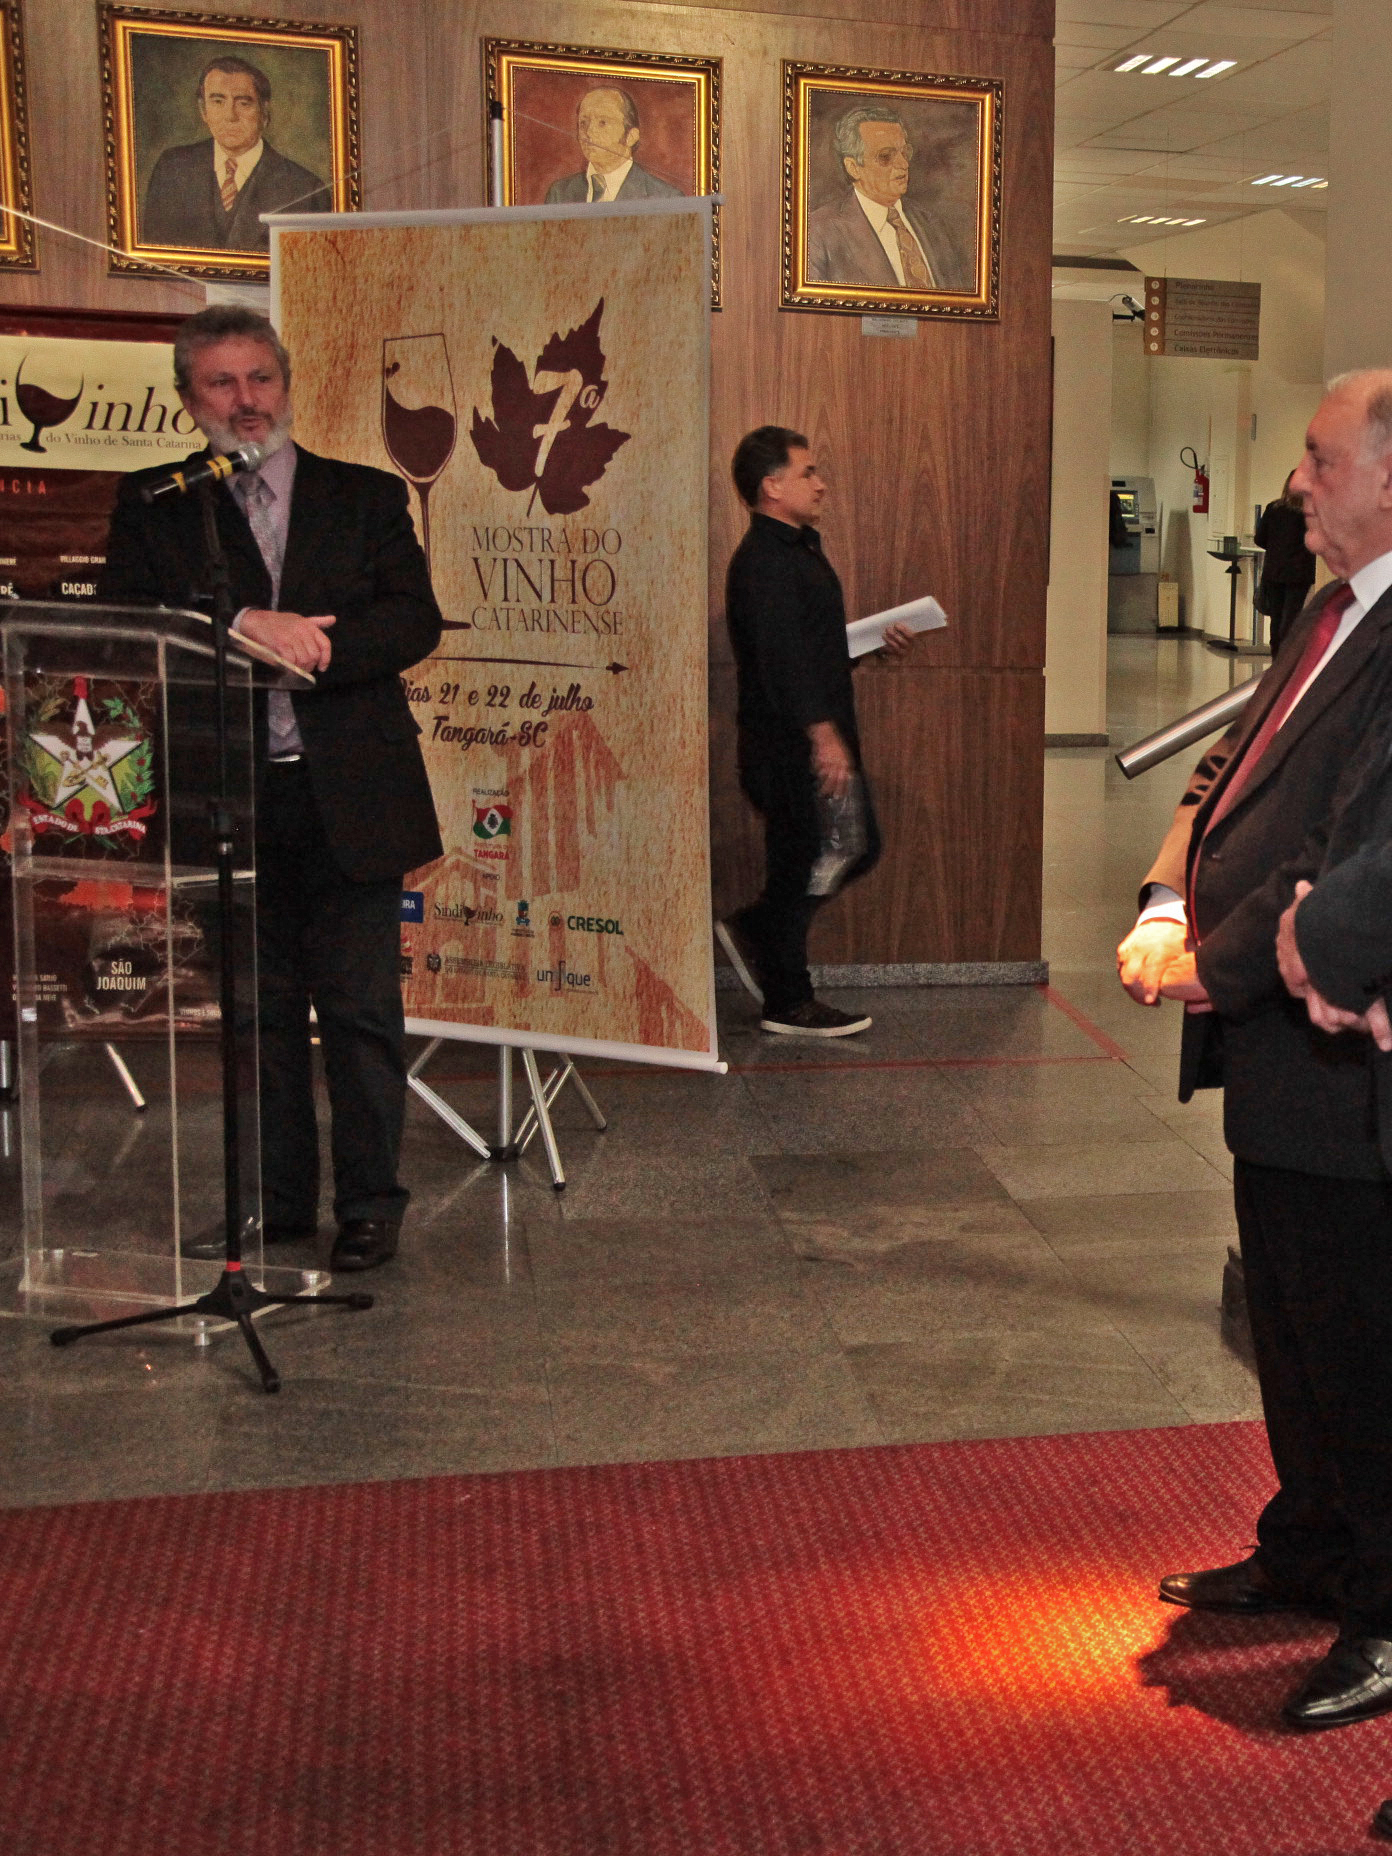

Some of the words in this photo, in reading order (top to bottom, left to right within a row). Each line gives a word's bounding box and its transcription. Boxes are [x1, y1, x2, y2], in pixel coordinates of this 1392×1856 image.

[45, 432, 61, 443] do
[64, 433, 100, 445] Vinho
[103, 434, 118, 446] de
[121, 435, 153, 447] Santa
[156, 437, 202, 449] Catarina
[472, 526, 571, 555] MOSTRA
[582, 528, 622, 556] DO
[61, 582, 97, 599] CAÇAD
[471, 557, 616, 607] VINHO
[471, 606, 624, 636] CATARINENSE
[439, 682, 460, 705] 21
[468, 689, 480, 706] e
[484, 684, 510, 709] 22
[519, 681, 543, 710] de
[541, 682, 595, 717] julho
[431, 715, 549, 751] Tangará-SC
[567, 915, 625, 936] CRESOL
[110, 957, 133, 975] SÃO
[96, 976, 147, 992] JOAQUIM
